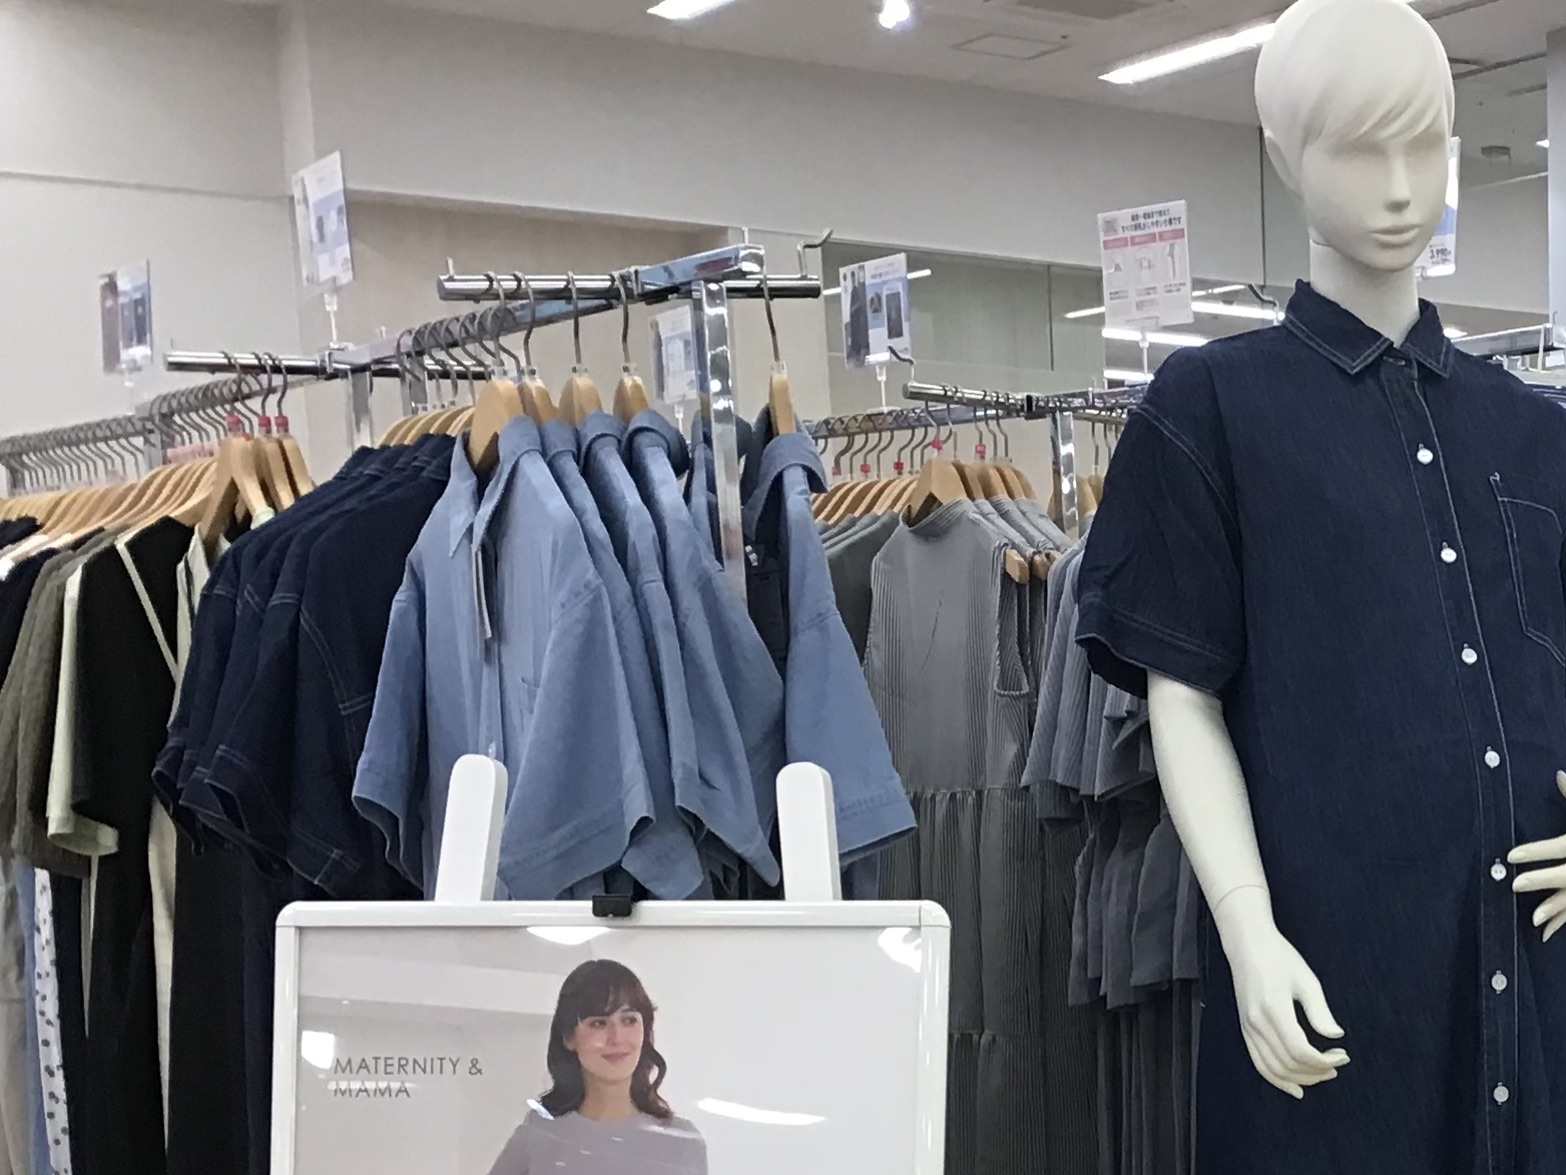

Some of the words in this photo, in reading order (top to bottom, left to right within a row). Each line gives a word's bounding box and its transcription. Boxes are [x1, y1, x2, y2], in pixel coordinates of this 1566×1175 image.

[334, 1056, 460, 1076] MATERNITY
[468, 1057, 484, 1076] &
[333, 1080, 411, 1099] MAMA
